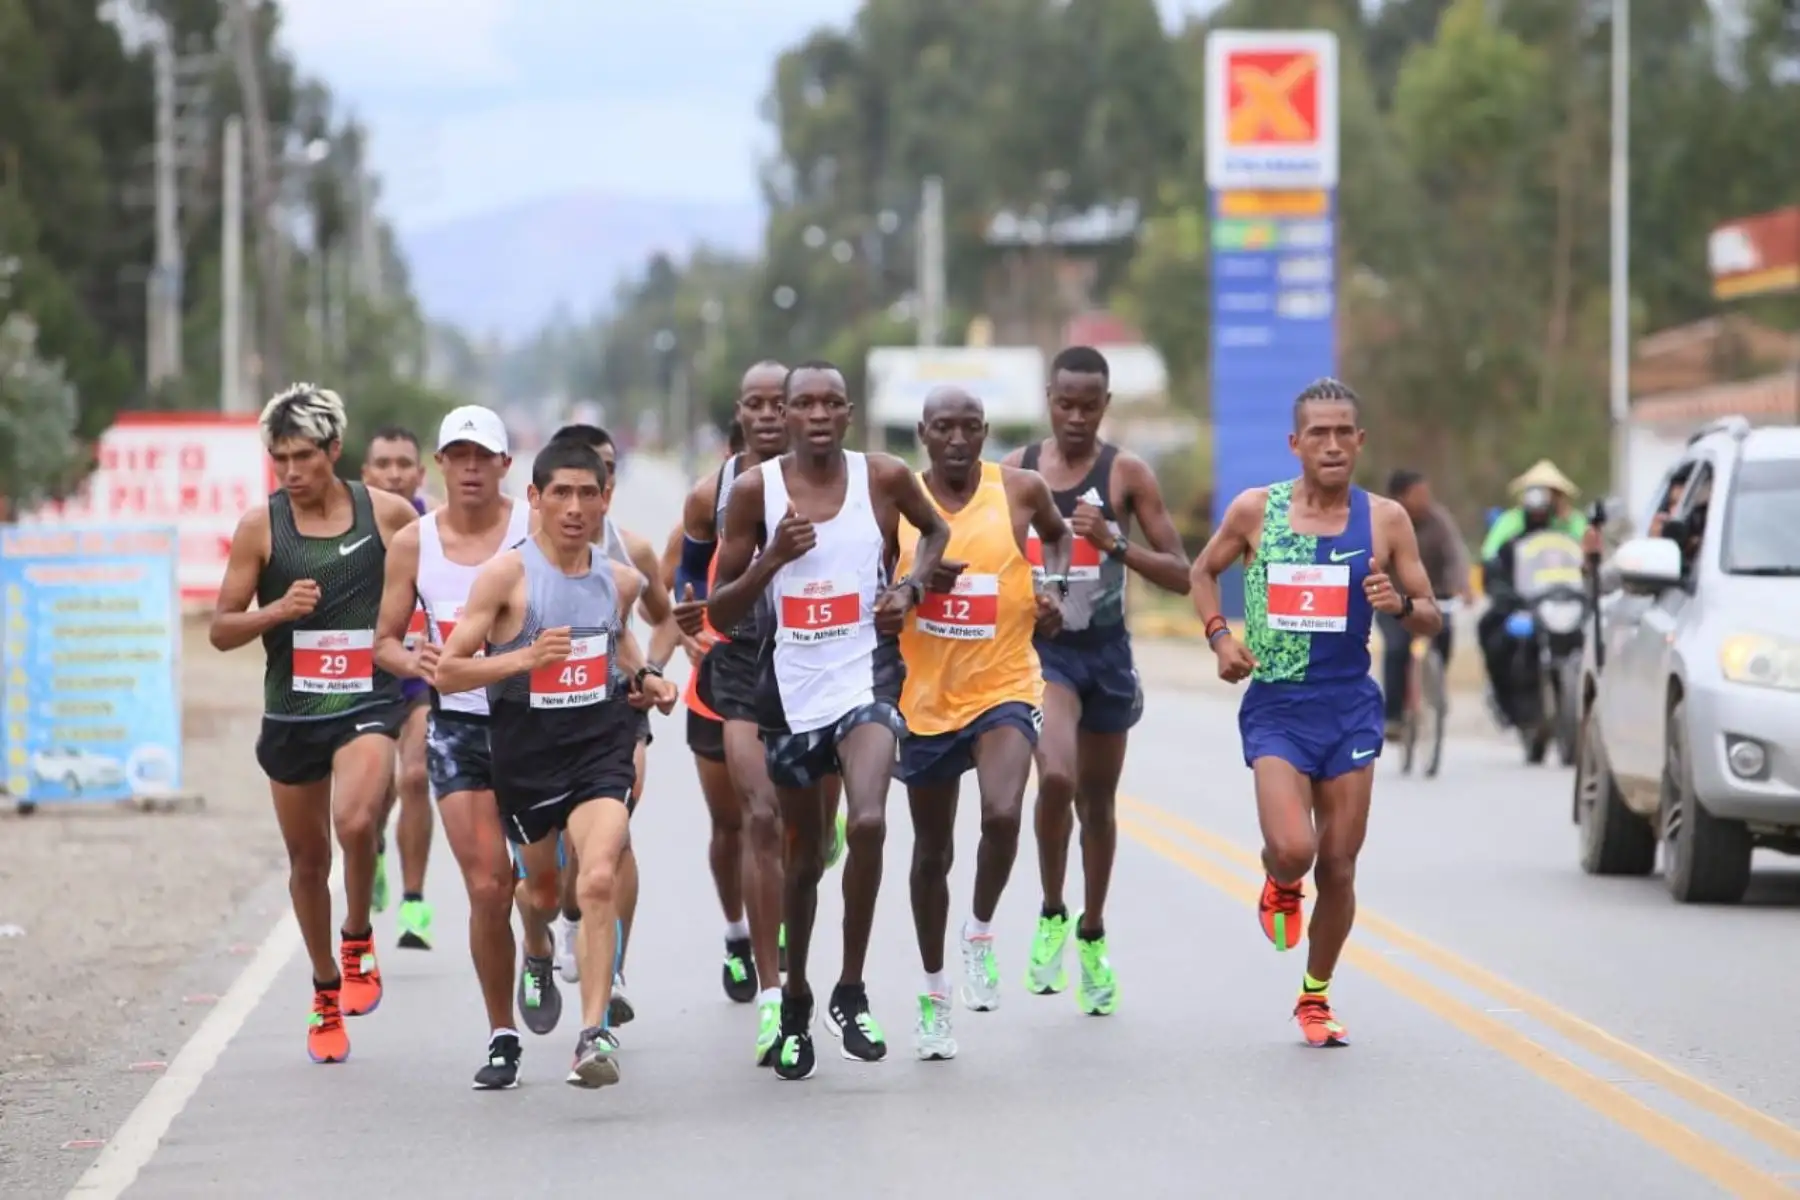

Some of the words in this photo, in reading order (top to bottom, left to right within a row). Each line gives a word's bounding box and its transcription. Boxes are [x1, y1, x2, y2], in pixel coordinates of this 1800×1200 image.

[1300, 590, 1314, 611] 2
[805, 603, 832, 625] 15
[942, 599, 970, 620] 12
[949, 626, 985, 636] Athletic
[1277, 618, 1297, 628] New
[1300, 619, 1336, 628] Athletic
[813, 627, 850, 640] Athletic
[320, 655, 347, 675] 29
[558, 664, 588, 688] 46
[328, 681, 362, 690] Athletic
[567, 691, 599, 704] Athletic
